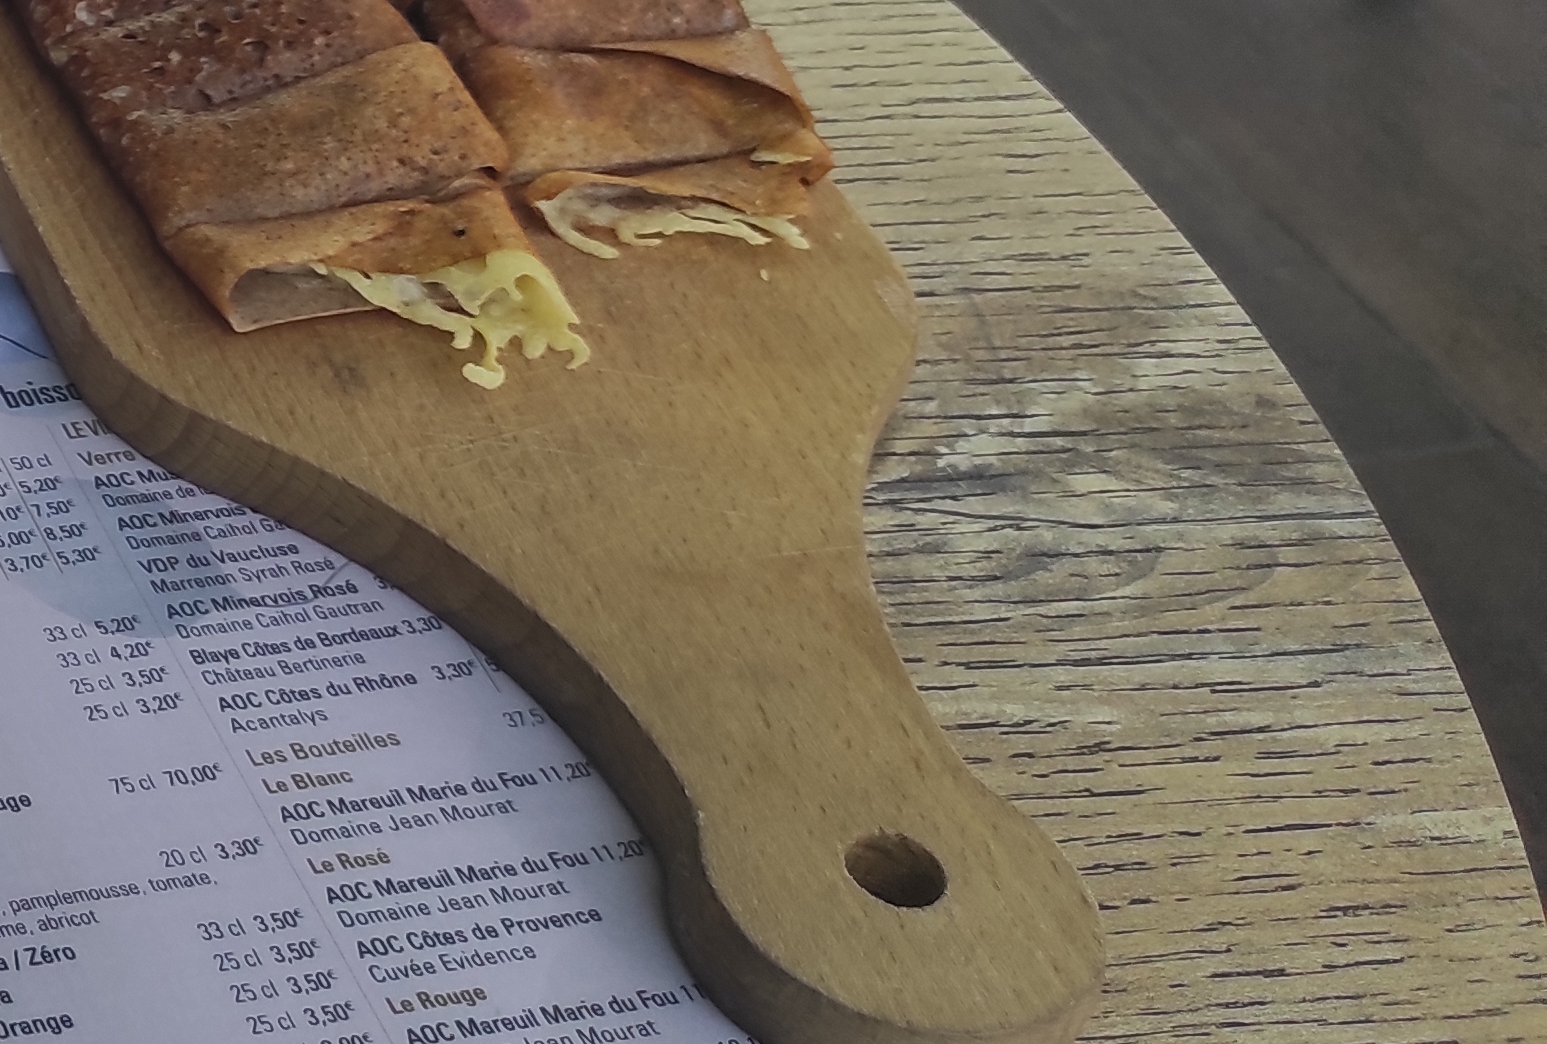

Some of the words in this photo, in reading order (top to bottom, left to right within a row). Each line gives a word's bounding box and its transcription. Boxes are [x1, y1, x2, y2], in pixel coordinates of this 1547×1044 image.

[244, 749, 288, 767] Les
[288, 732, 402, 760] Bouteilles
[306, 857, 335, 875] Le
[335, 847, 391, 871] Rosé
[356, 934, 405, 960] AOC
[405, 929, 469, 951] Côtes
[471, 922, 500, 941] de
[499, 908, 604, 936] Provence
[384, 997, 416, 1015] Le
[415, 987, 488, 1010] Rouge
